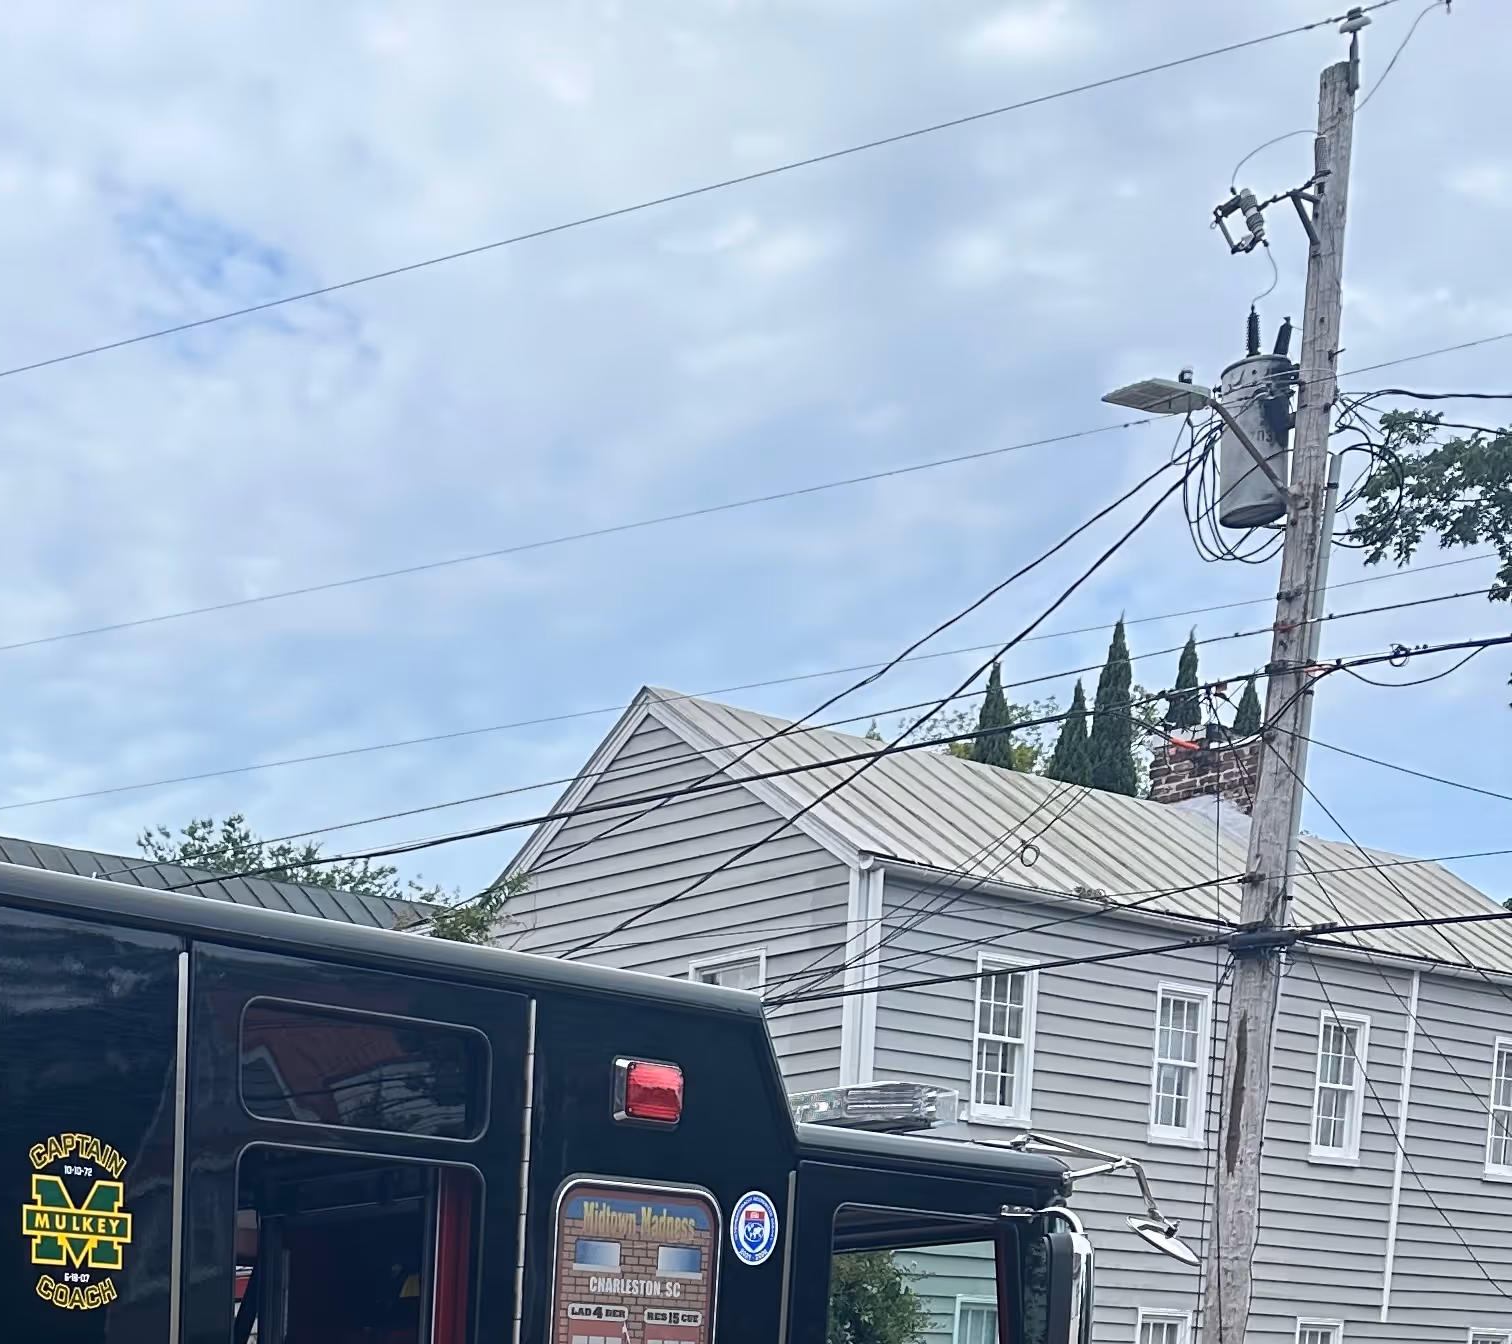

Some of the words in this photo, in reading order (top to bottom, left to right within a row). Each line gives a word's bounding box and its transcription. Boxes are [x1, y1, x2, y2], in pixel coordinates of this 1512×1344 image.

[29, 1133, 127, 1179] CAPTAIN
[34, 1212, 120, 1234] MULKEY
[583, 1201, 638, 1236] Midtown
[640, 1206, 696, 1240] Madness
[36, 1274, 118, 1310] COACH
[665, 1281, 681, 1298] SC
[593, 1306, 603, 1319] 4
[668, 1311, 680, 1324] 15
